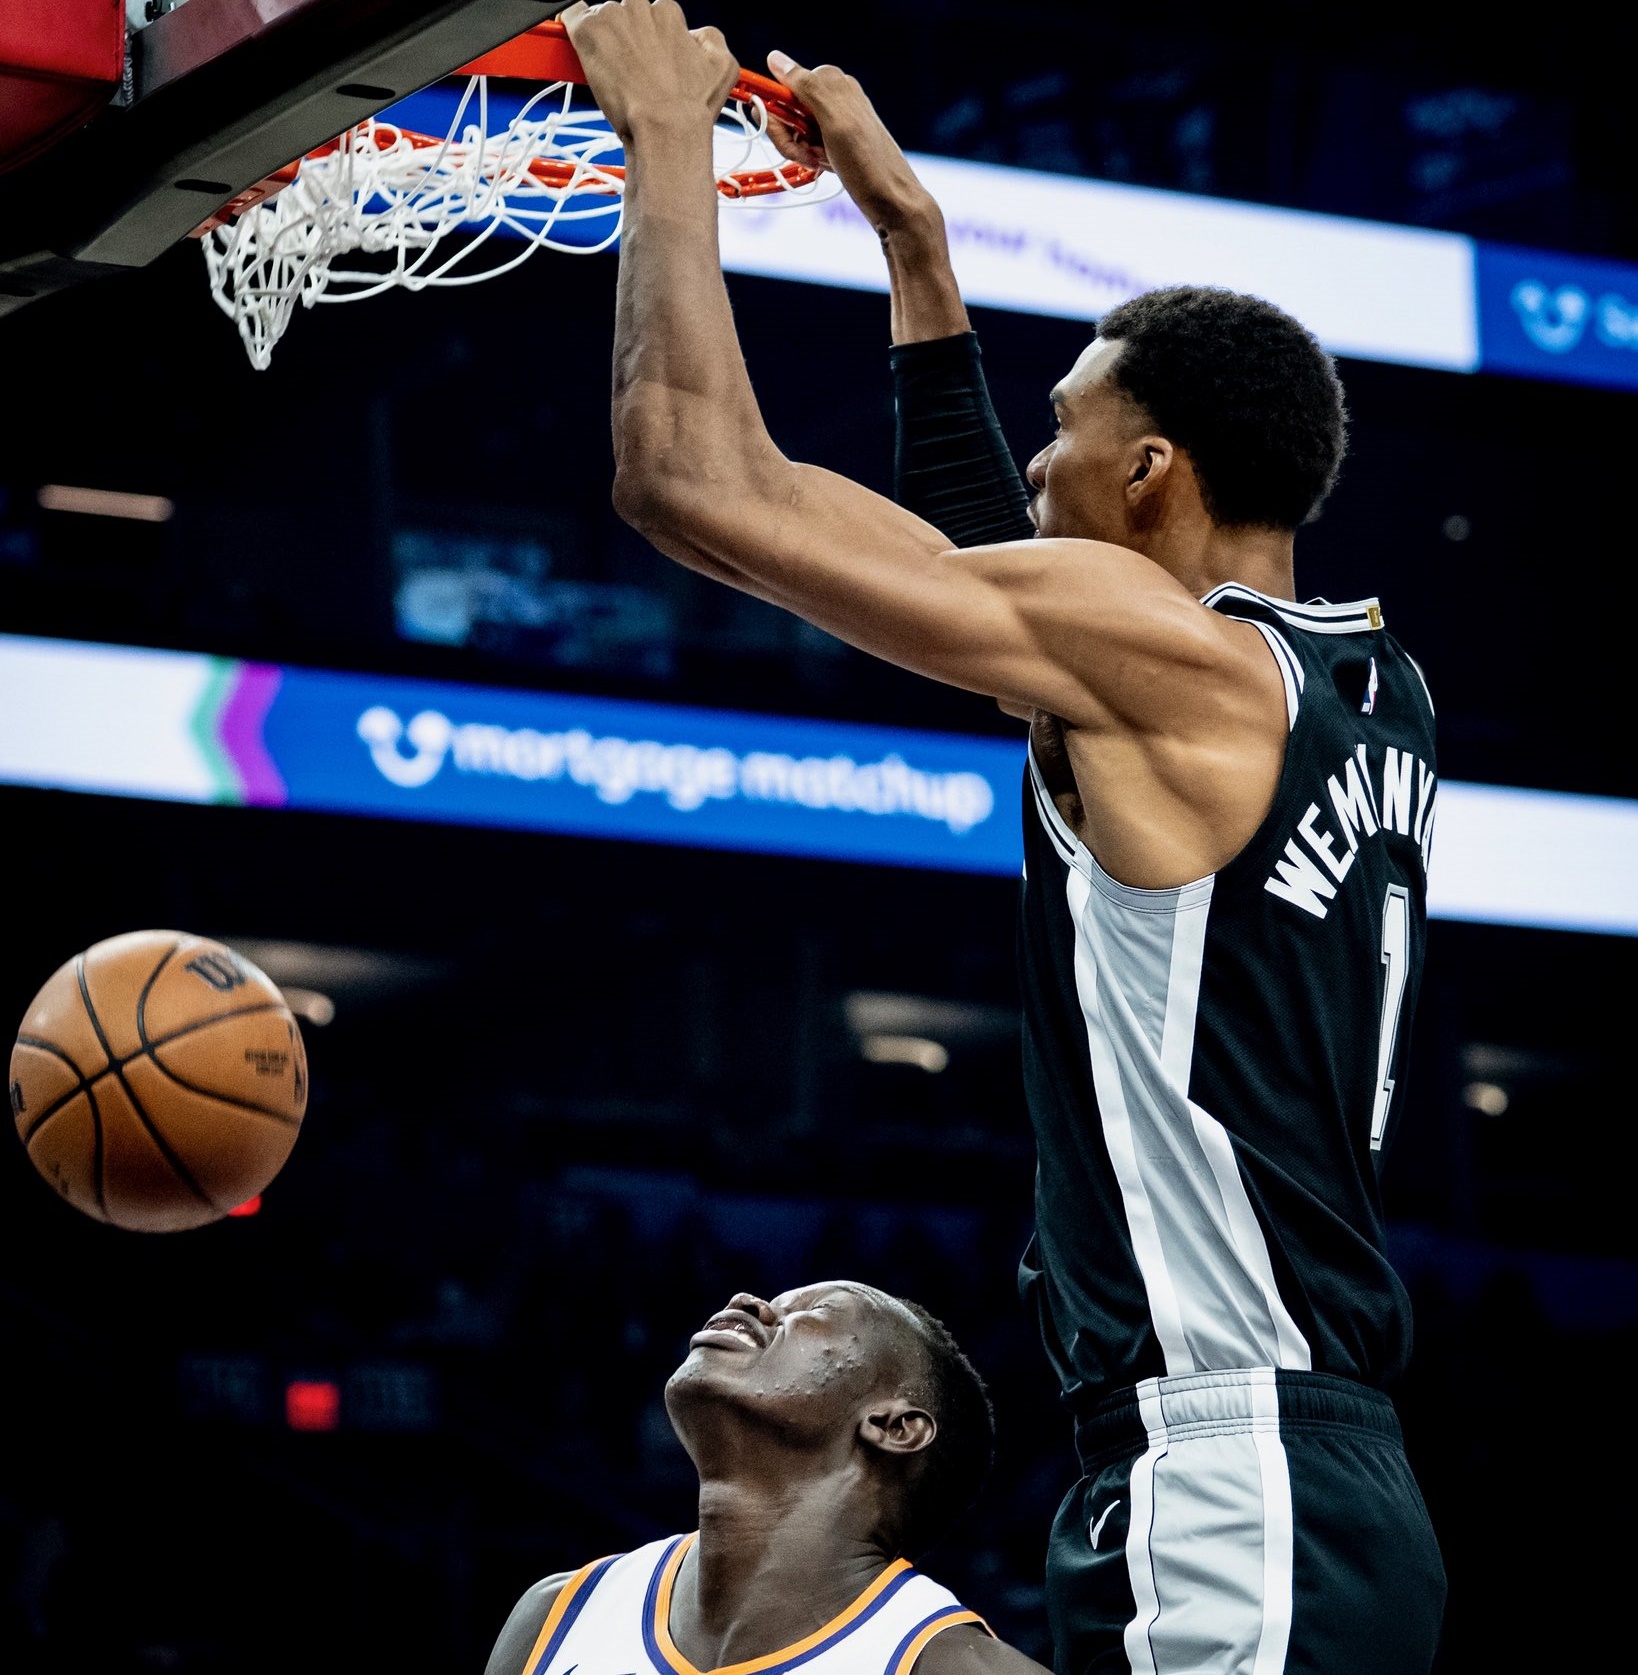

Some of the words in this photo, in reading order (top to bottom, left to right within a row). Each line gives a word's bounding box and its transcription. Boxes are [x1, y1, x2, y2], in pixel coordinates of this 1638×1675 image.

[452, 723, 736, 810] mortgage
[740, 752, 992, 832] matchup
[1370, 883, 1410, 1151] 1
